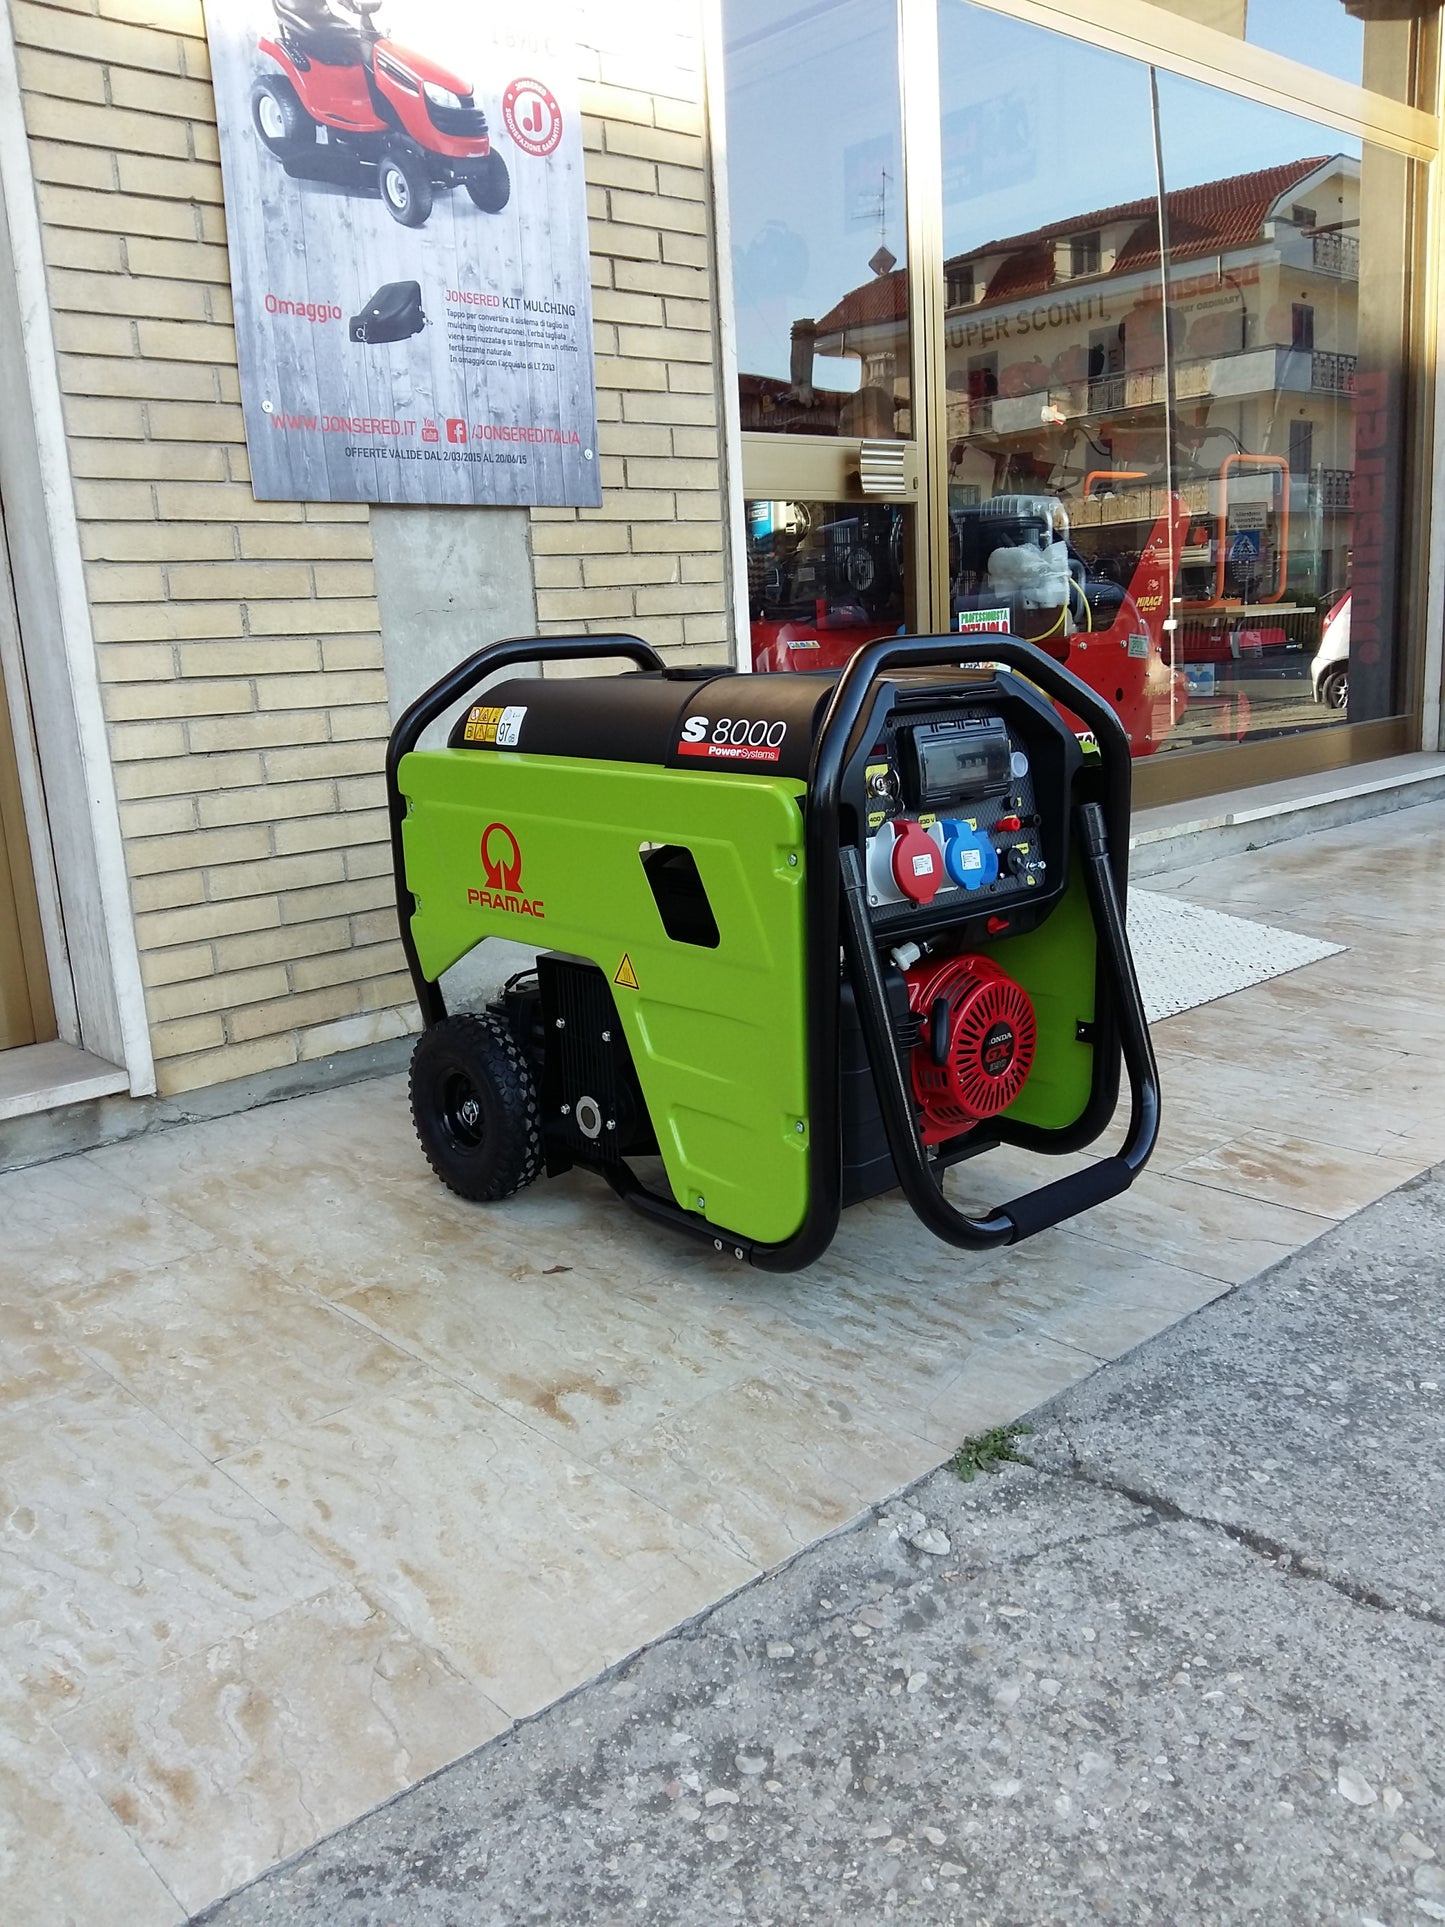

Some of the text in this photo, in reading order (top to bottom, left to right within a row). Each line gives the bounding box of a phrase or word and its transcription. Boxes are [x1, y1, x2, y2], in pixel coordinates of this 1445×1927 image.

[264, 293, 342, 323] Omaggio
[445, 289, 576, 317] JONSERED KIT MULCHING
[446, 308, 466, 320] Tappo
[466, 312, 477, 321] per
[478, 313, 509, 323] convertire
[515, 317, 539, 327] sistema
[546, 320, 563, 331] taglio
[447, 321, 476, 333] mulching
[545, 330, 567, 341] tagliata
[448, 332, 465, 342] viene
[466, 333, 501, 345] sminuzzata
[514, 339, 544, 350] trasforma
[448, 343, 486, 355] fertilizzante
[450, 354, 458, 363] In
[458, 356, 485, 368] omaggio
[486, 359, 497, 367] con
[269, 413, 416, 436] WWW.JONSERED.IT
[472, 424, 581, 446] /JONSEREDITALIA
[344, 446, 528, 465] OFFERTE VALIDE DAL 2/03/2015 AL 20/06/15
[1135, 595, 1163, 608] MIRAGE
[498, 722, 512, 743] 97
[681, 715, 787, 748] S 8000
[707, 744, 776, 761] PowerSystems
[869, 815, 881, 823] 400
[467, 888, 545, 919] PRAMAC
[985, 1041, 1011, 1064] GX
